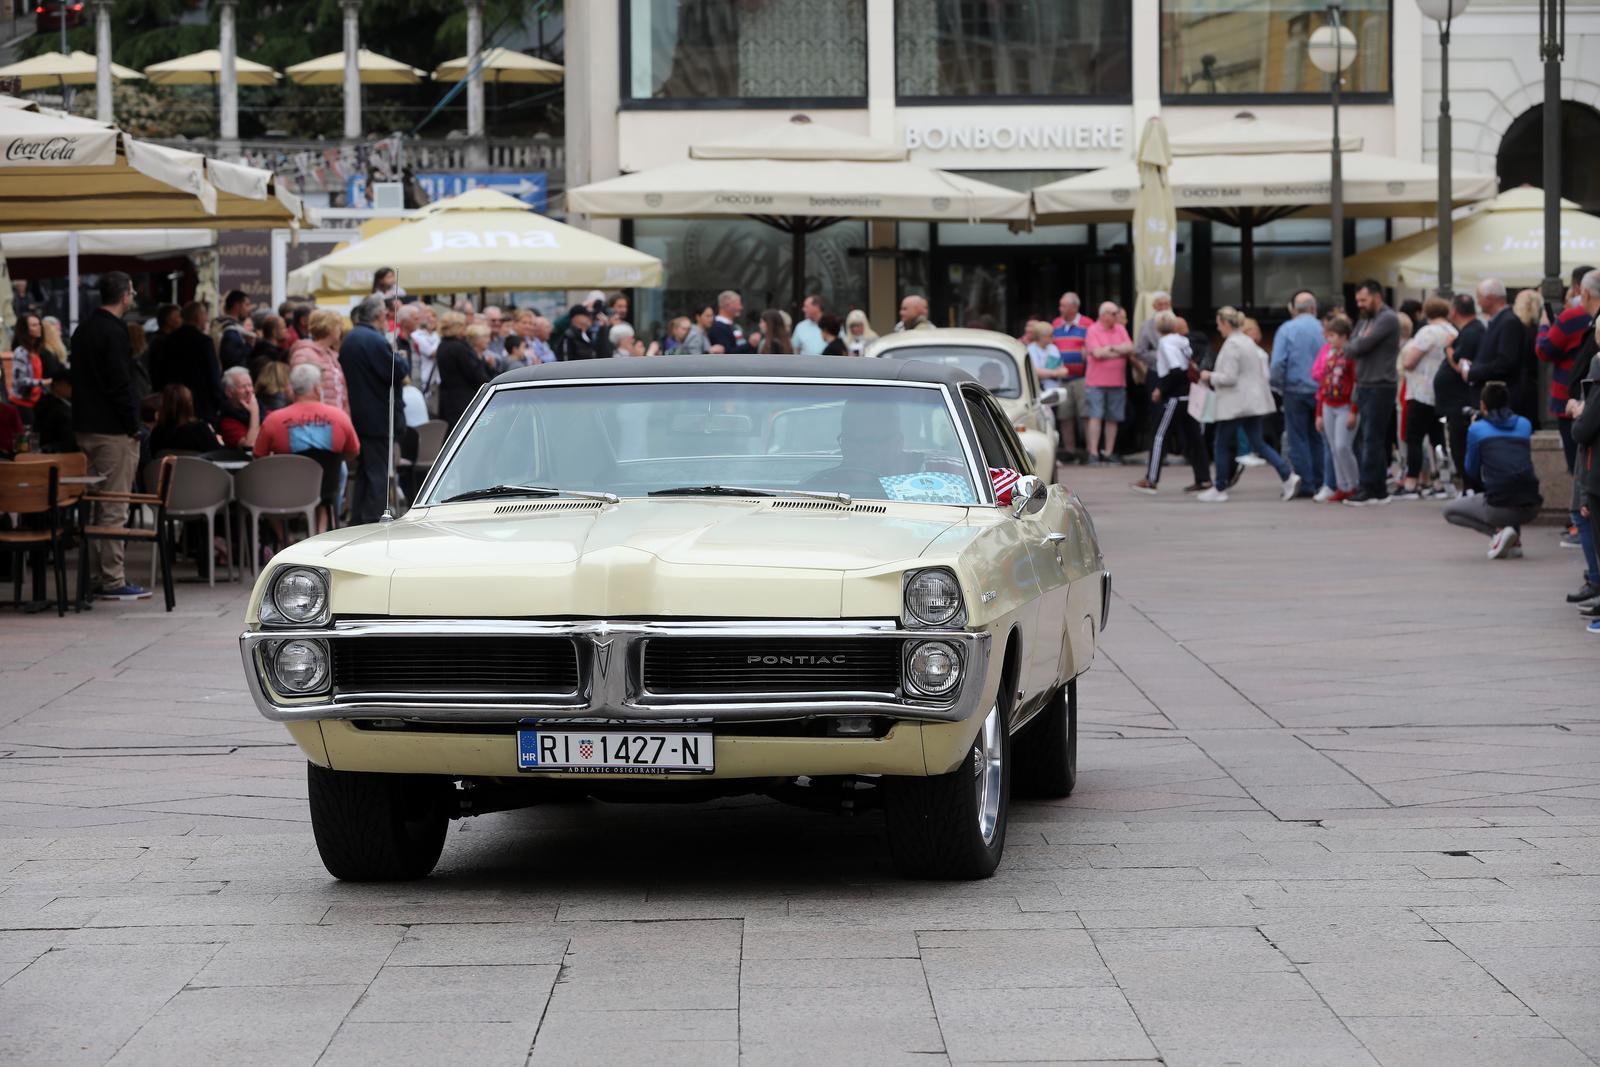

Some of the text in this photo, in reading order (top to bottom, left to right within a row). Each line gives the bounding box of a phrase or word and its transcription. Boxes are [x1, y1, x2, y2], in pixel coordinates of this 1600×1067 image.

[905, 124, 1124, 149] BONBONNIERE
[715, 194, 774, 205] CHOCO BAR
[747, 655, 846, 664] PONTIAC
[541, 735, 699, 764] RI 1427-N
[522, 753, 537, 761] HR
